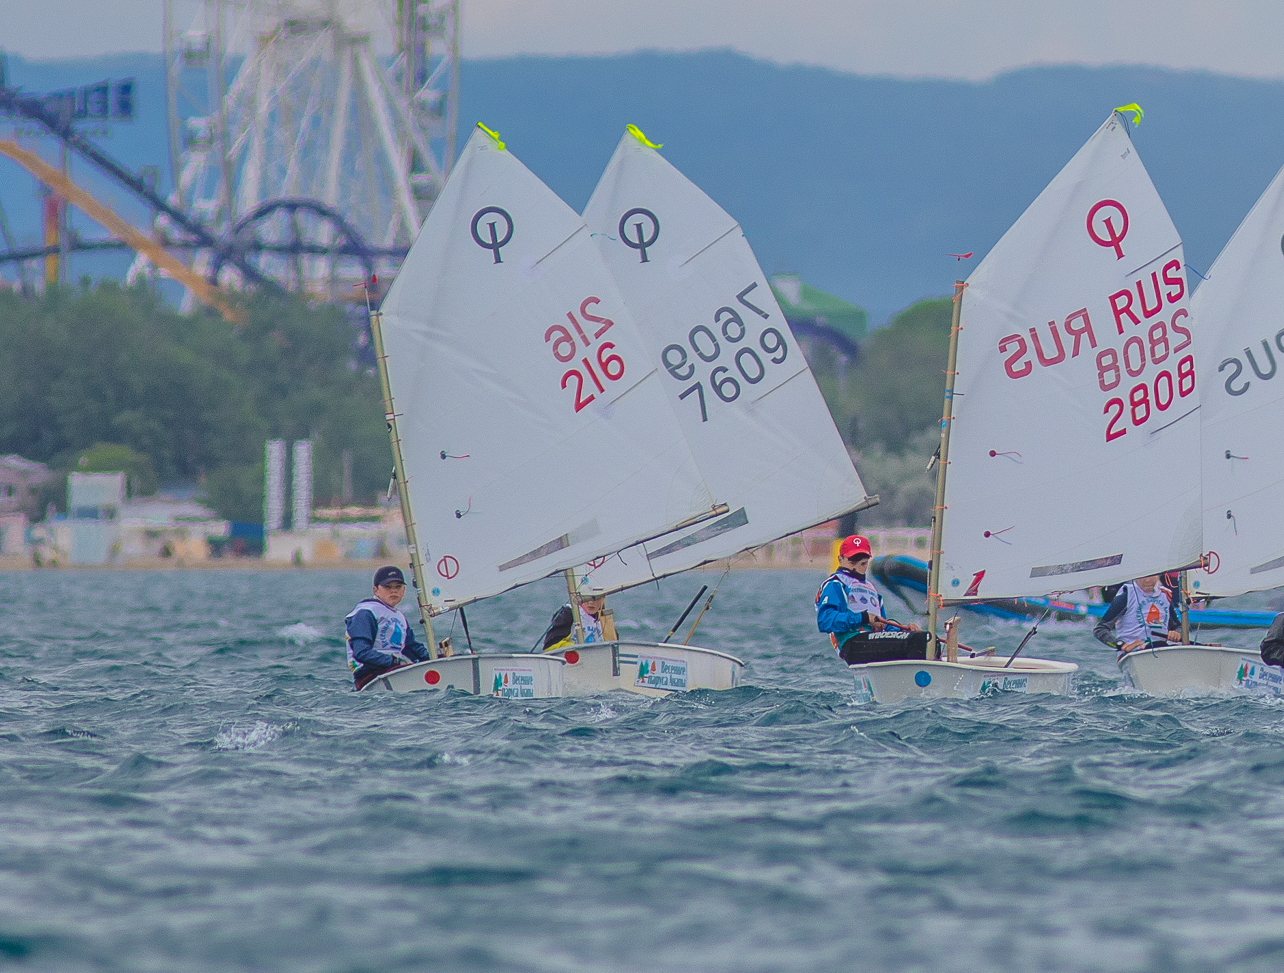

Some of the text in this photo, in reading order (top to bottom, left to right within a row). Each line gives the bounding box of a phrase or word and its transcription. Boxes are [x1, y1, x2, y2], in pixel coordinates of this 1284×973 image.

[1108, 258, 1186, 335] RUS
[560, 341, 625, 413] 216
[678, 327, 789, 423] 7609
[1103, 354, 1197, 442] 2808
